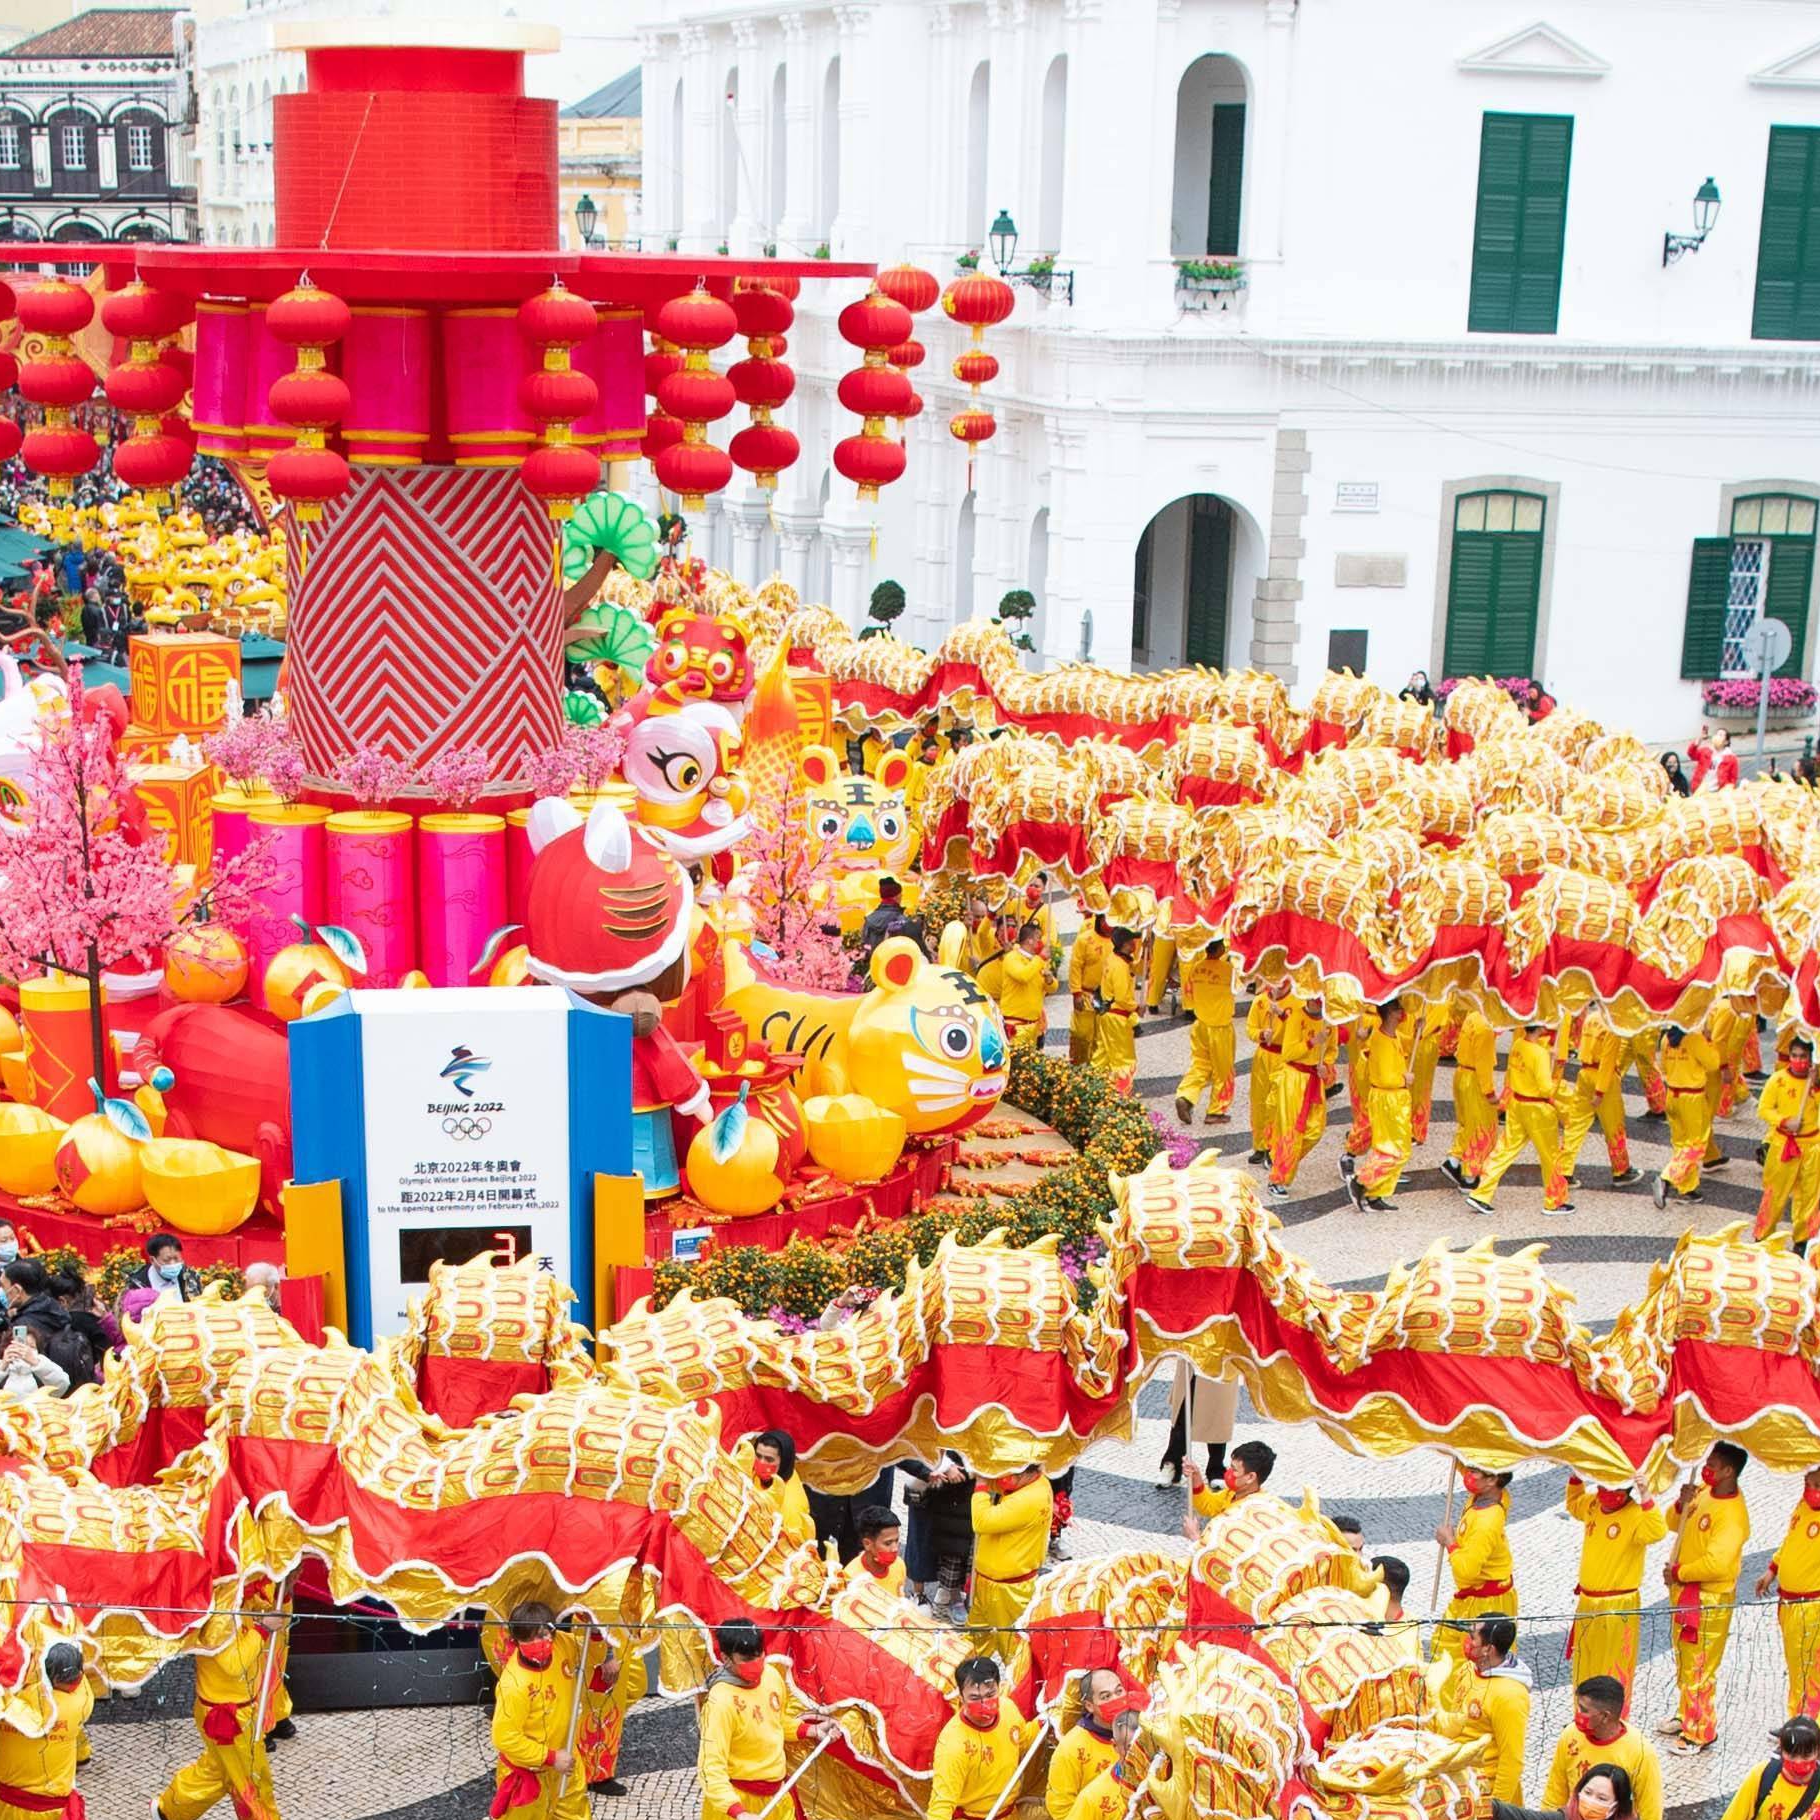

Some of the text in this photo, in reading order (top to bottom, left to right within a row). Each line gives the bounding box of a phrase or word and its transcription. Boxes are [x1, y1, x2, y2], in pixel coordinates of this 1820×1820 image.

[133, 649, 159, 723] 福
[166, 652, 230, 726] 福
[844, 783, 875, 806] 王
[941, 972, 988, 1005] 王
[427, 1102, 506, 1116] BEIJING 2022
[414, 1160, 522, 1174] 北京2022年冬奧會
[399, 1174, 537, 1186] Olympic Winter Games Beijing 2022
[401, 1188, 537, 1204] 距2022年2月4日開幕式
[377, 1206, 386, 1214] to
[387, 1205, 401, 1213] the
[402, 1204, 434, 1214] opening
[435, 1203, 475, 1213] ceremony
[476, 1203, 487, 1211] on
[488, 1201, 523, 1212] February
[538, 1256, 555, 1272] 天
